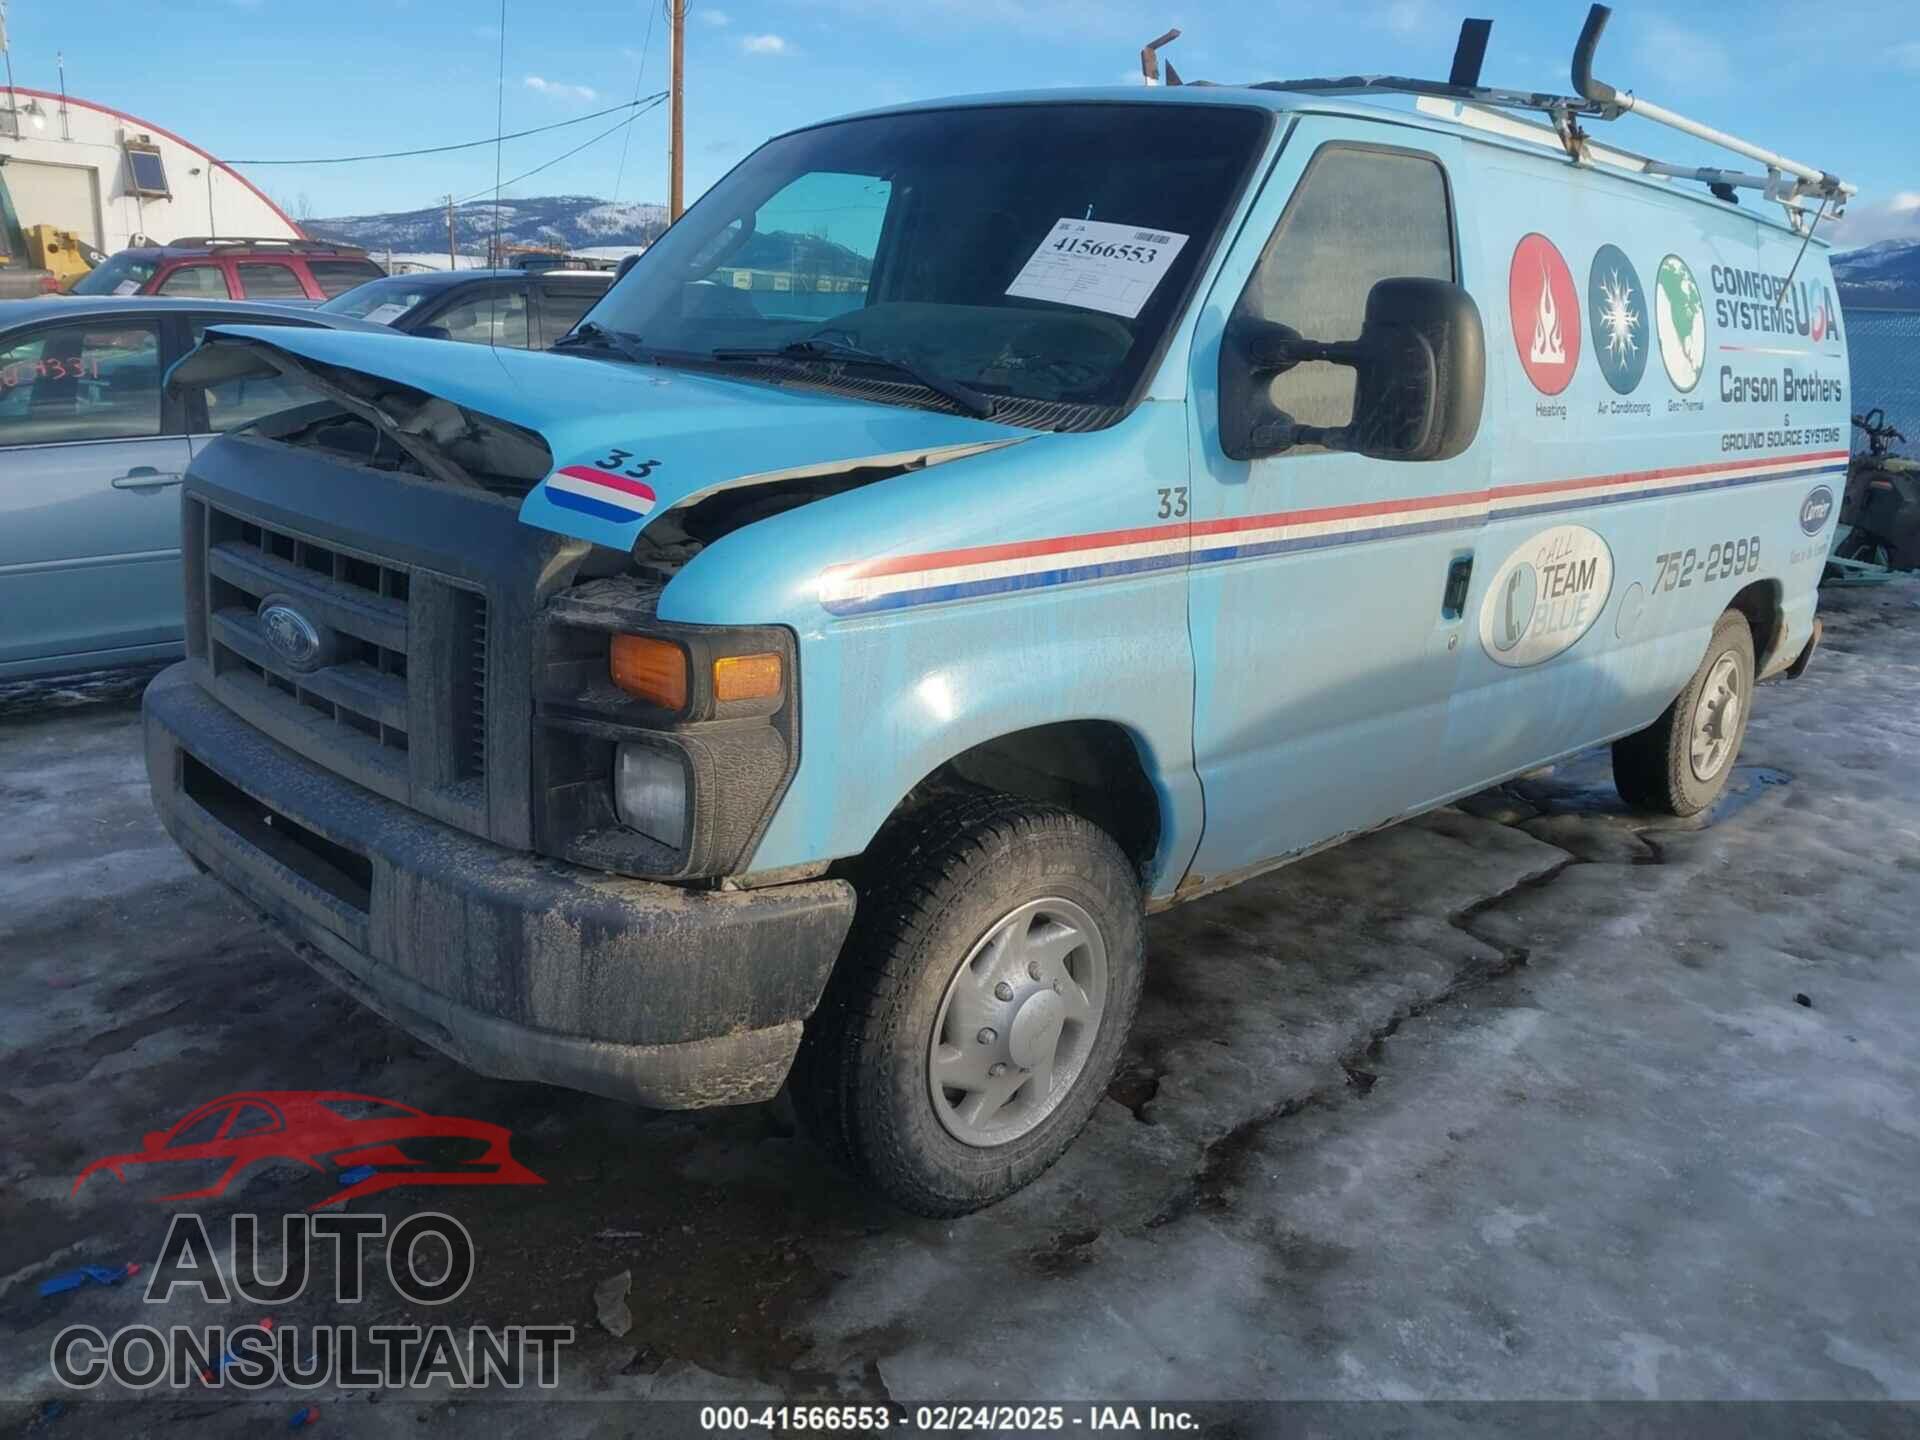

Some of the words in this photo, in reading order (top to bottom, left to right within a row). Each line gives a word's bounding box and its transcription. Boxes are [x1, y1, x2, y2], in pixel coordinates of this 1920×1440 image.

[1053, 236, 1158, 265] 41566553
[1711, 264, 1793, 303] COMFORT
[1716, 299, 1795, 335] SYSTEMS
[1720, 365, 1778, 402] Carson
[1783, 367, 1842, 402] Brothers
[1535, 402, 1567, 420] Heating
[1610, 401, 1651, 416] Conditioning
[1721, 432, 1765, 452] GROUND
[1767, 429, 1802, 448] SOURCE
[1804, 427, 1840, 445] SYSTEMS
[594, 448, 662, 478] 33
[1157, 487, 1187, 519] 33
[1543, 557, 1597, 600] TEAM
[1651, 536, 1760, 595] 752-2998
[1534, 593, 1590, 636] BLUE
